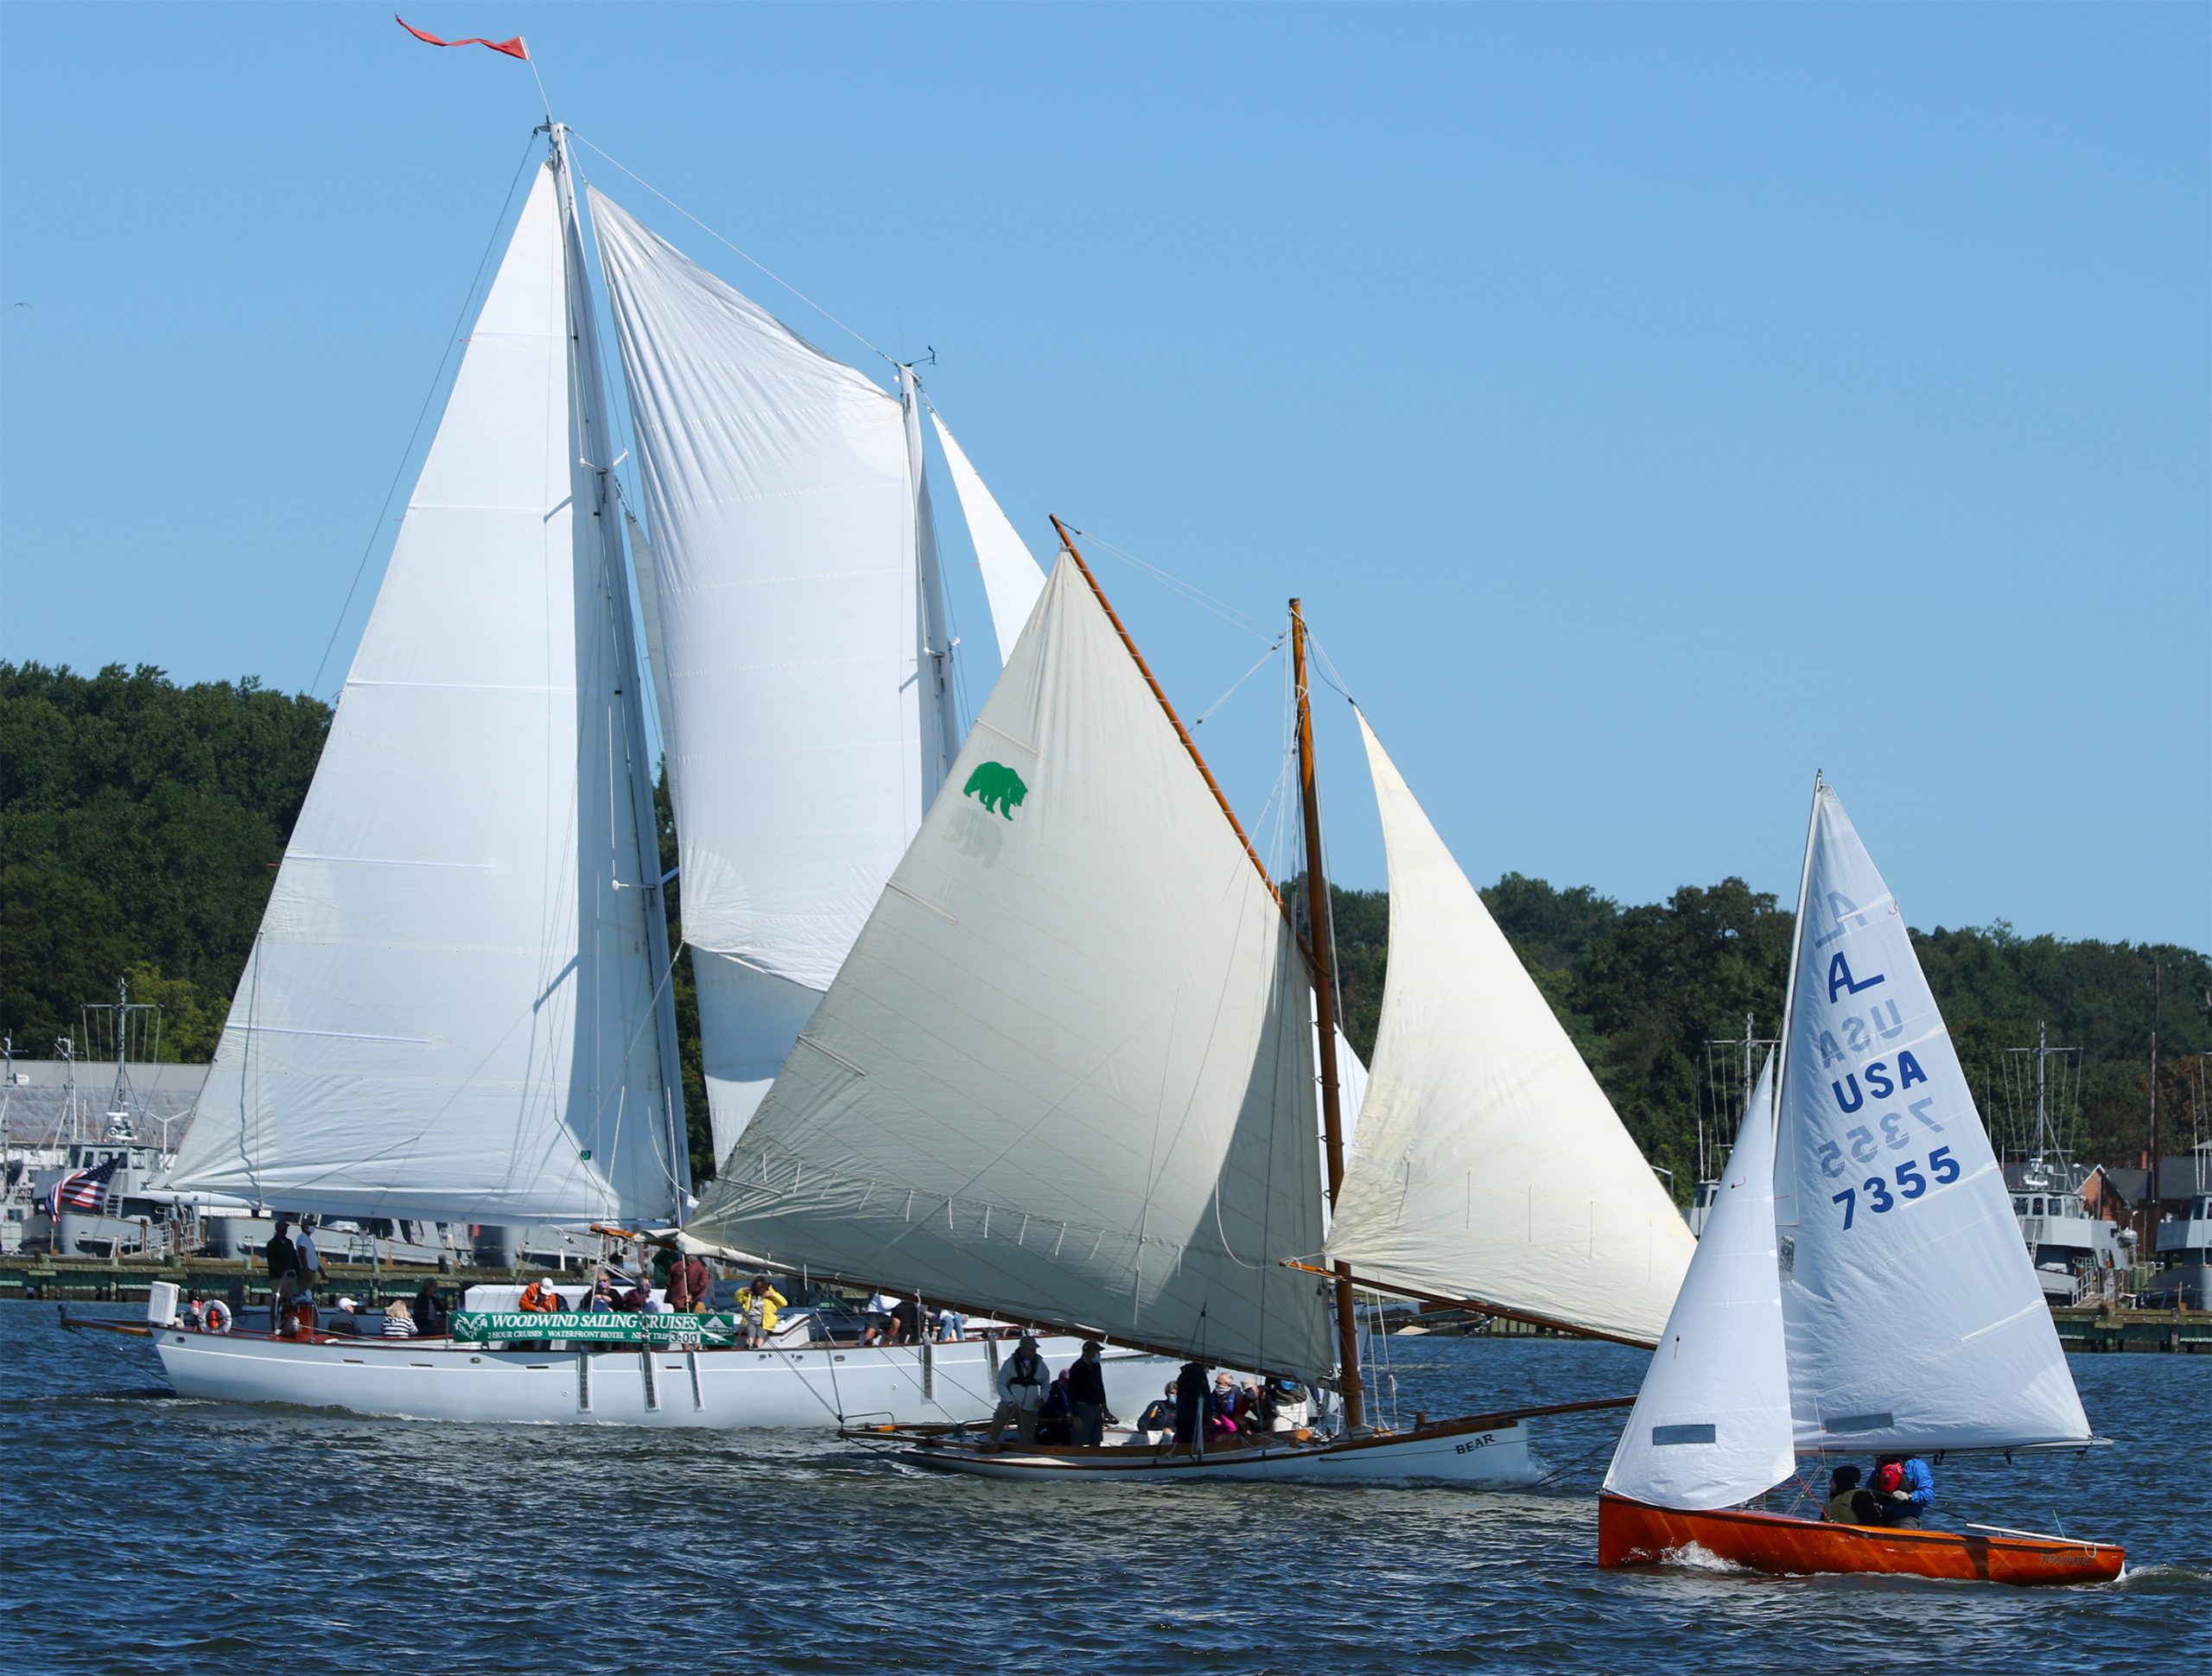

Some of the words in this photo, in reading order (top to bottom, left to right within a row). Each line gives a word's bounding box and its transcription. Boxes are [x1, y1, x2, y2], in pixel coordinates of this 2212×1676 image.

[1831, 1050, 1929, 1114] USA
[1832, 1145, 1961, 1231] 7355
[492, 1314, 579, 1328] WOODWIND
[580, 1314, 638, 1329] SAILING
[493, 1330, 512, 1339] HOUR
[513, 1330, 543, 1338] CRUISES
[671, 1332, 697, 1343] 3:00
[1455, 1434, 1496, 1455] BEAR
